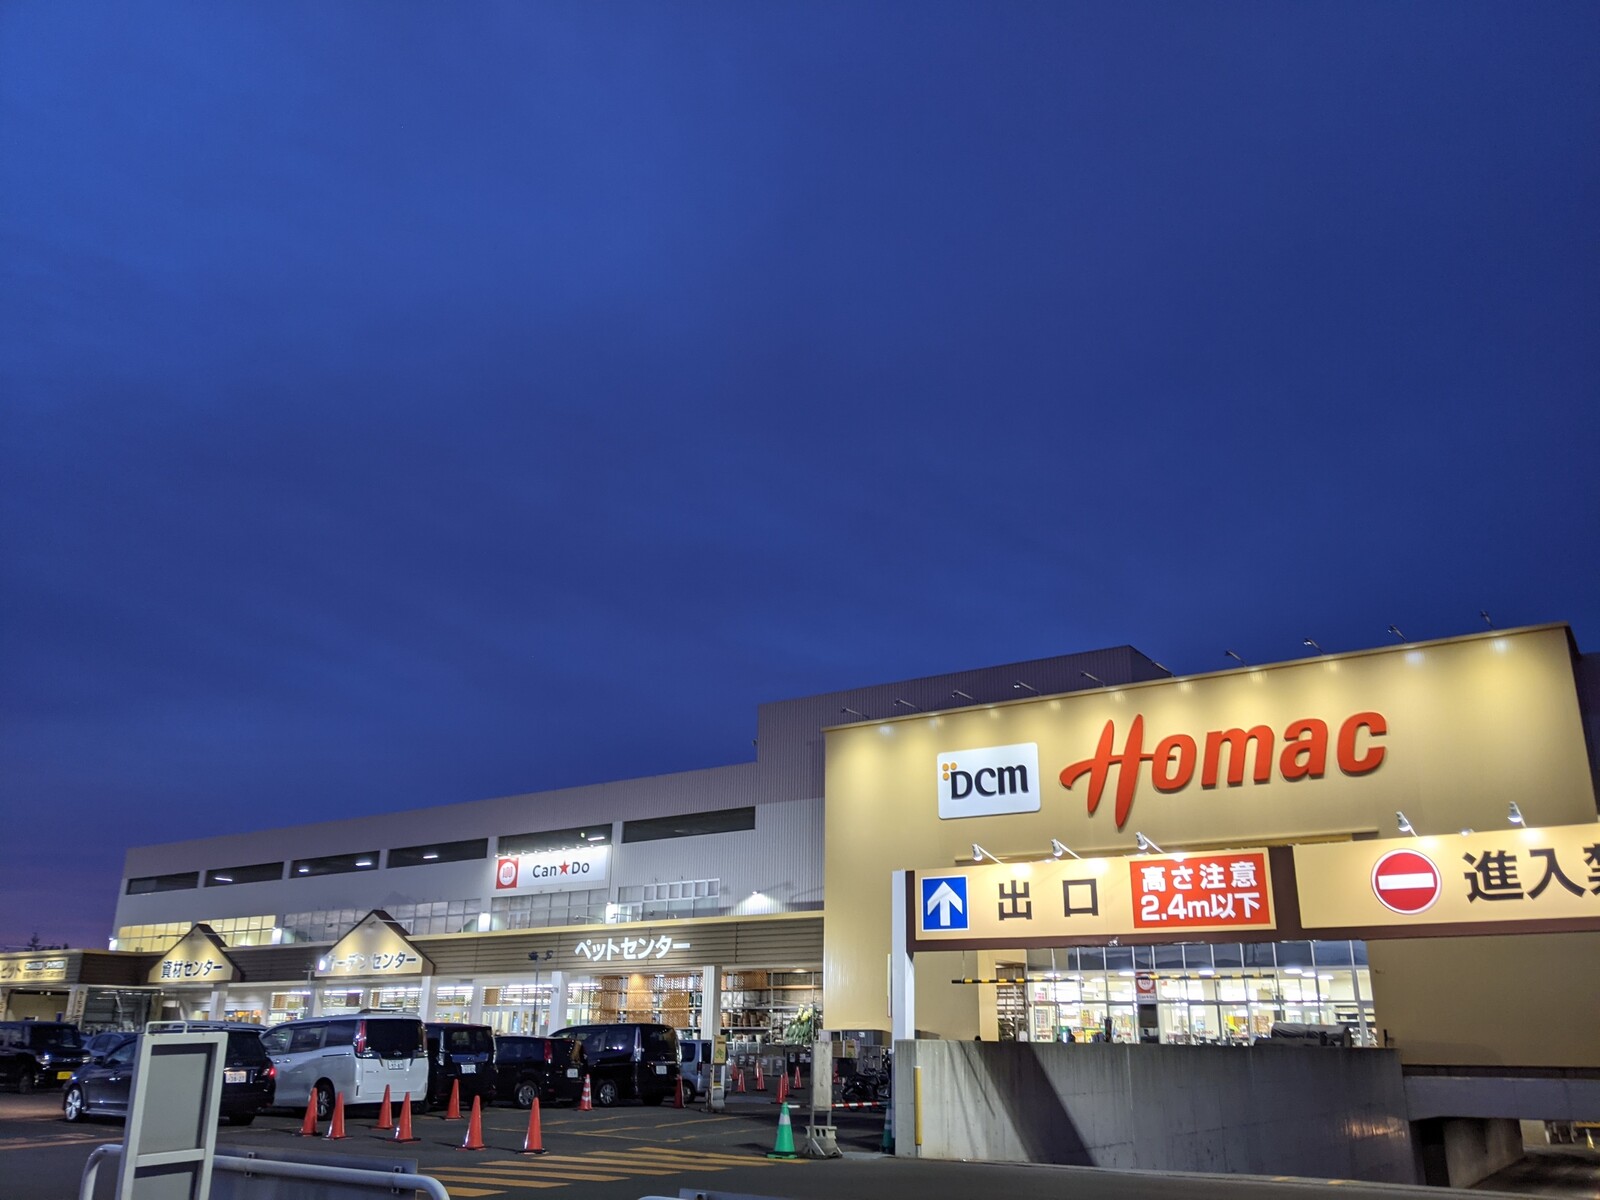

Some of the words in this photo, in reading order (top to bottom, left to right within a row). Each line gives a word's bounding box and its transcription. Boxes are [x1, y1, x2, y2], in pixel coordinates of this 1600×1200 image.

[1059, 711, 1388, 829] Homac
[1140, 860, 1258, 893] 高さ注意
[1462, 842, 1600, 904] 進入
[998, 878, 1099, 921] 出口
[1140, 892, 1261, 922] 2.4m以下
[574, 935, 691, 962] ペットセンター
[161, 959, 223, 979] 資材センター
